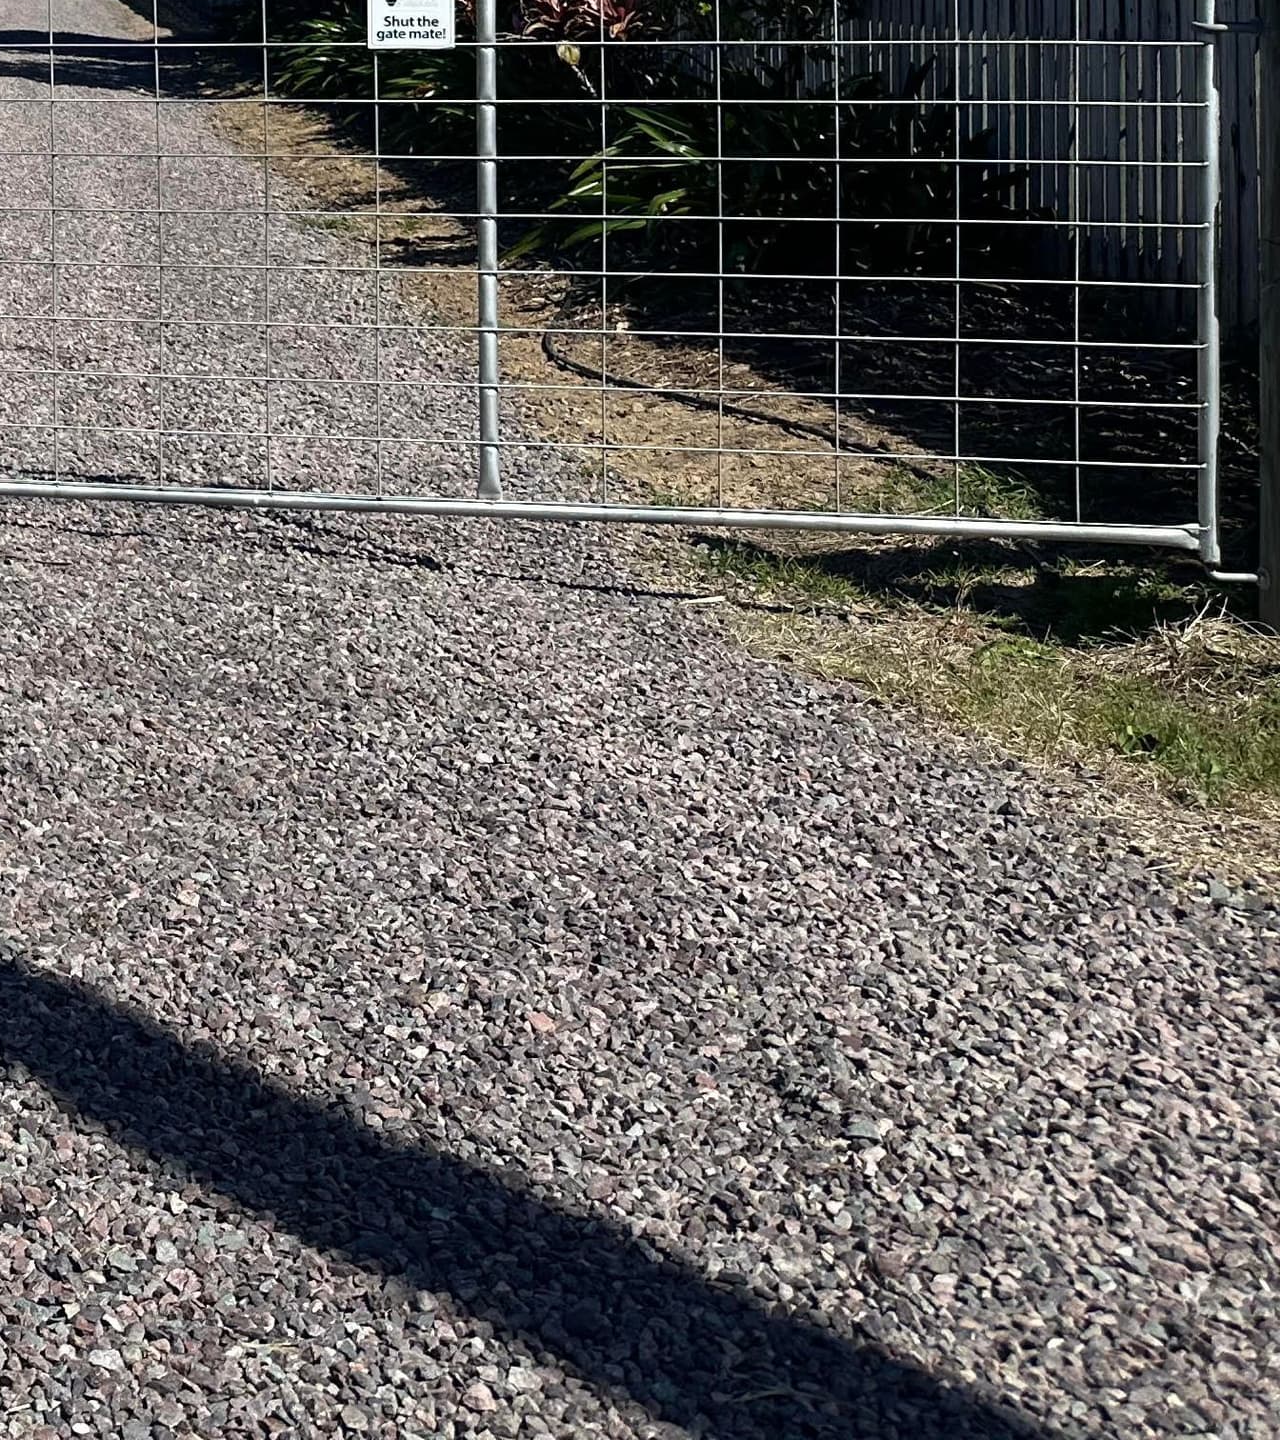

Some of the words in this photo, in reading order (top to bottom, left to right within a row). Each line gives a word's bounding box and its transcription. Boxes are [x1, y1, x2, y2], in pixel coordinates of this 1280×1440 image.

[383, 15, 416, 27] Shut
[417, 16, 439, 27] the
[376, 29, 406, 42] gate
[408, 28, 447, 39] mate!
